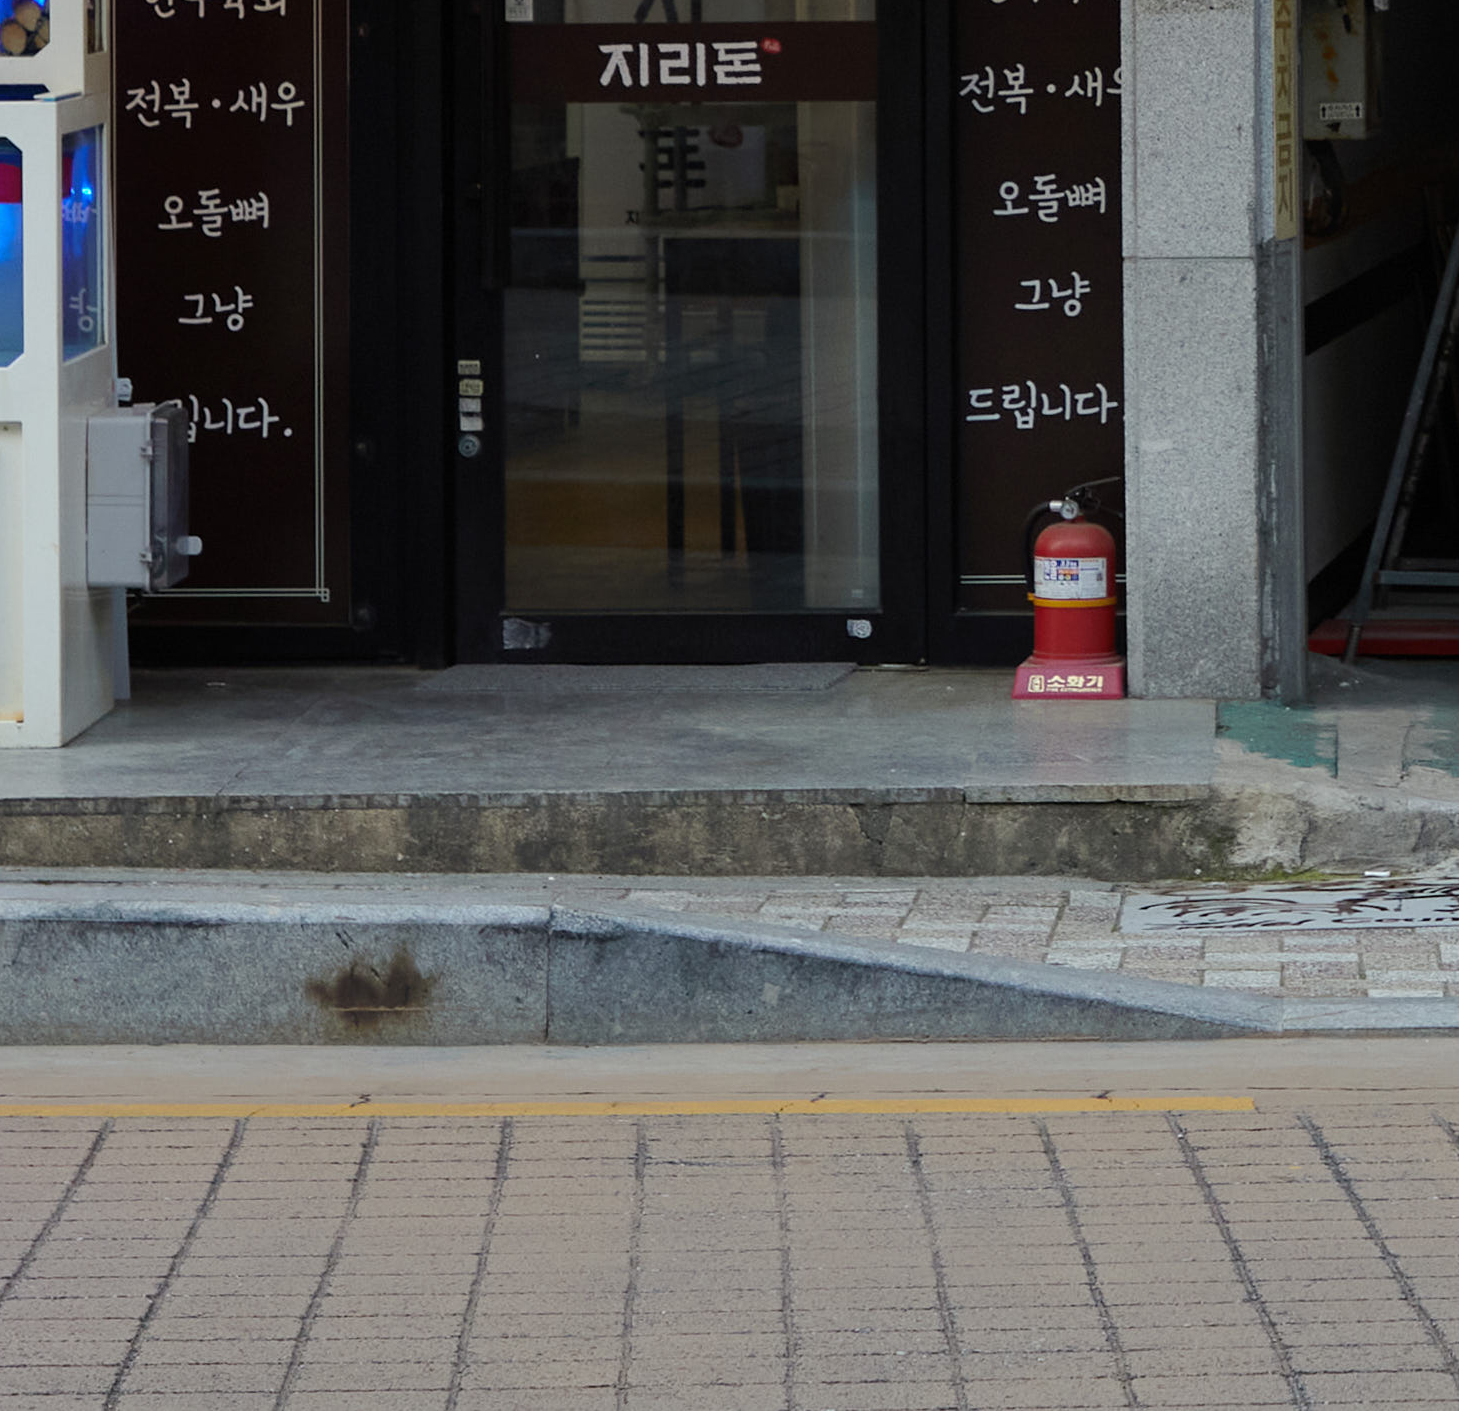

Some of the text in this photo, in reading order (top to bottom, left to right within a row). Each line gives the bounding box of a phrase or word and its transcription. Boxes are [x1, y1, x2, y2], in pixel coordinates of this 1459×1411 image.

[599, 42, 761, 86] 지리돈
[158, 189, 269, 237] 오돌뼈
[993, 174, 1106, 222] 오돌뼈
[179, 286, 253, 331] 그냥
[1014, 272, 1090, 317] 그냥
[1047, 674, 1103, 688] 소화기
